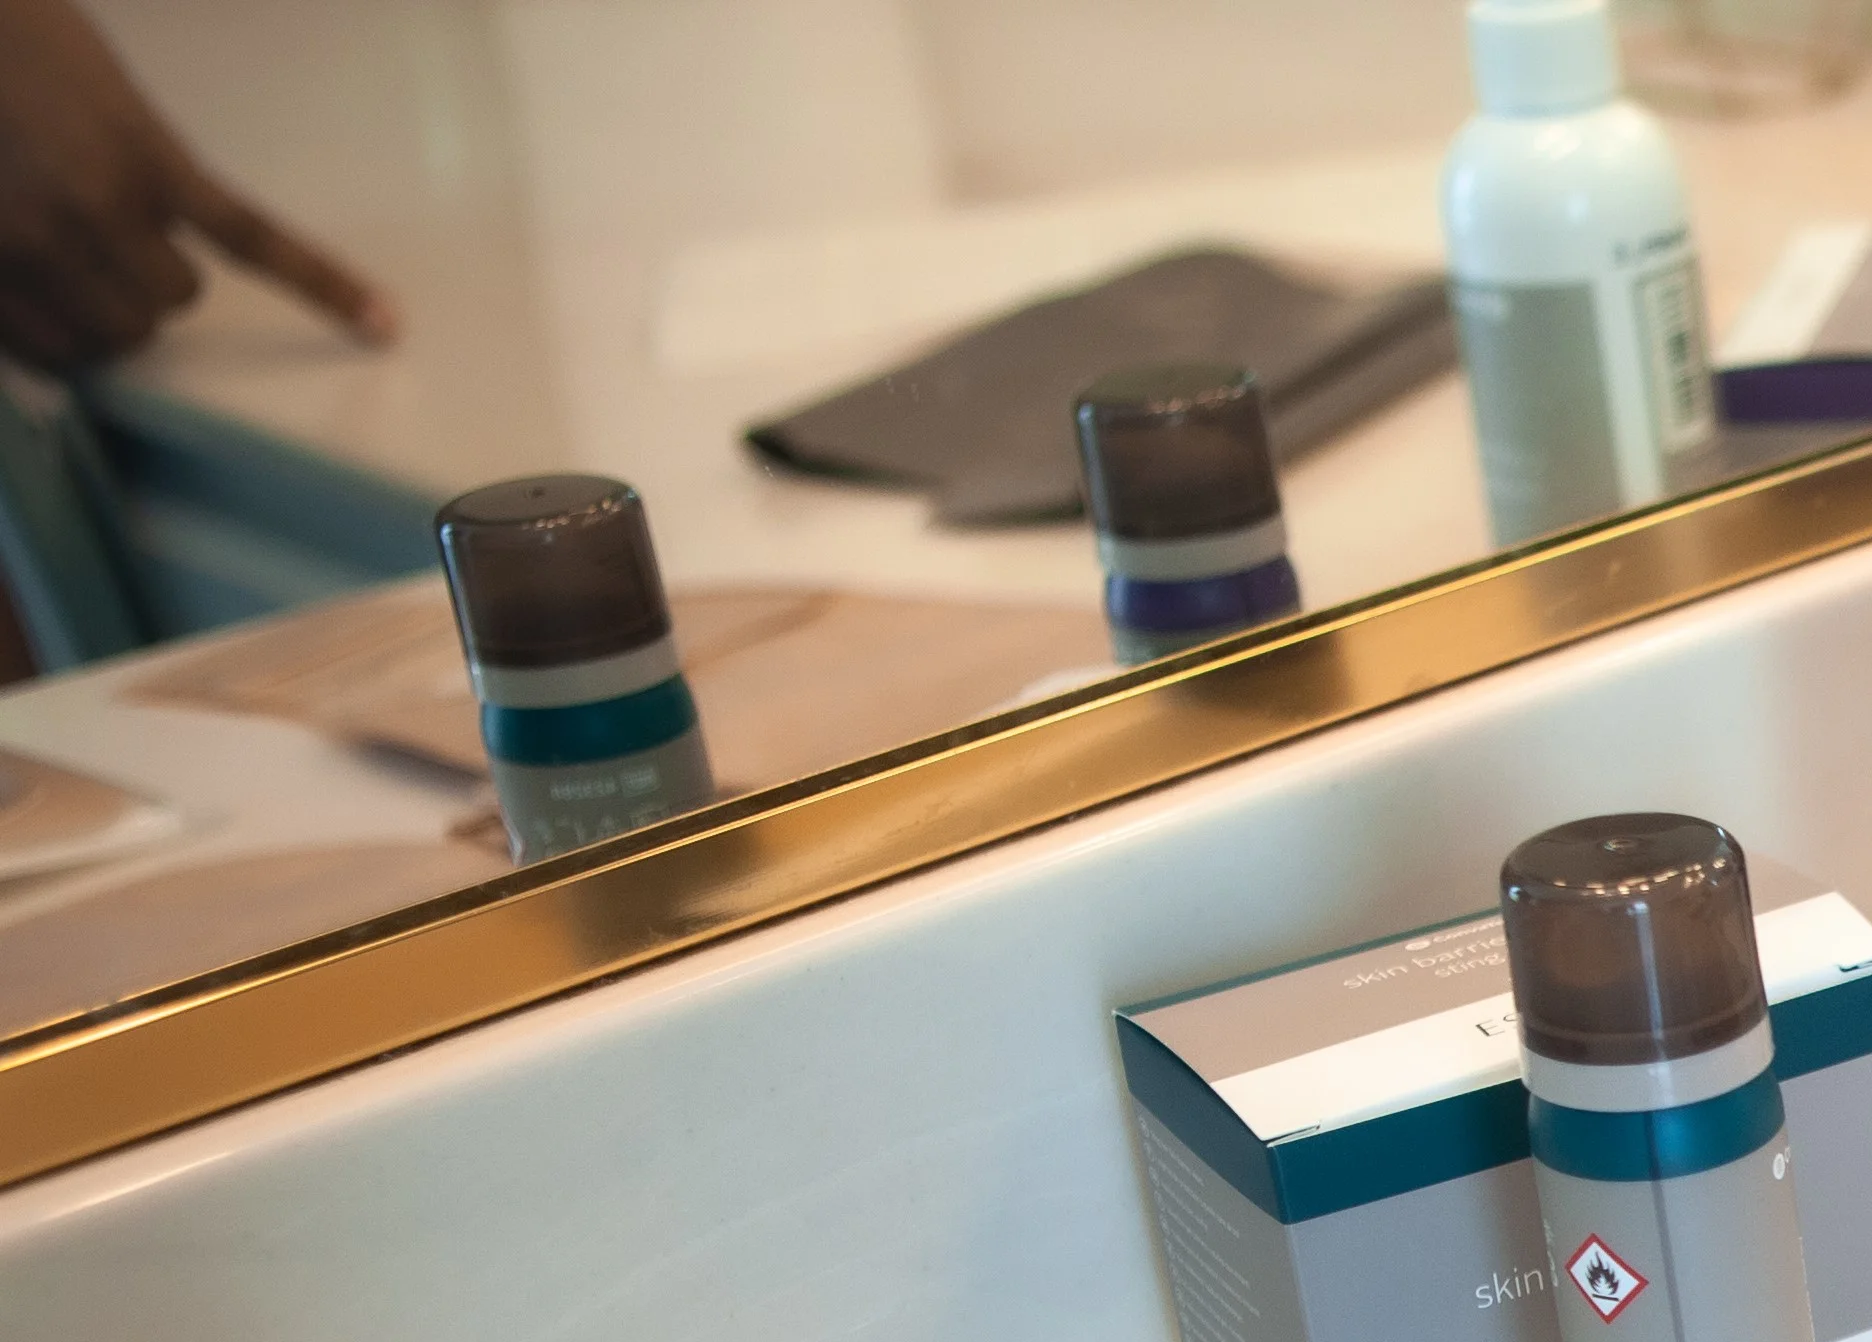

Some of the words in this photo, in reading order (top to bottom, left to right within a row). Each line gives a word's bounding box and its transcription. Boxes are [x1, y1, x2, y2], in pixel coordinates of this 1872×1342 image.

[1343, 965, 1408, 989] skin
[1412, 936, 1507, 968] barrie
[1435, 952, 1506, 978] sting
[1475, 1268, 1544, 1309] skin
